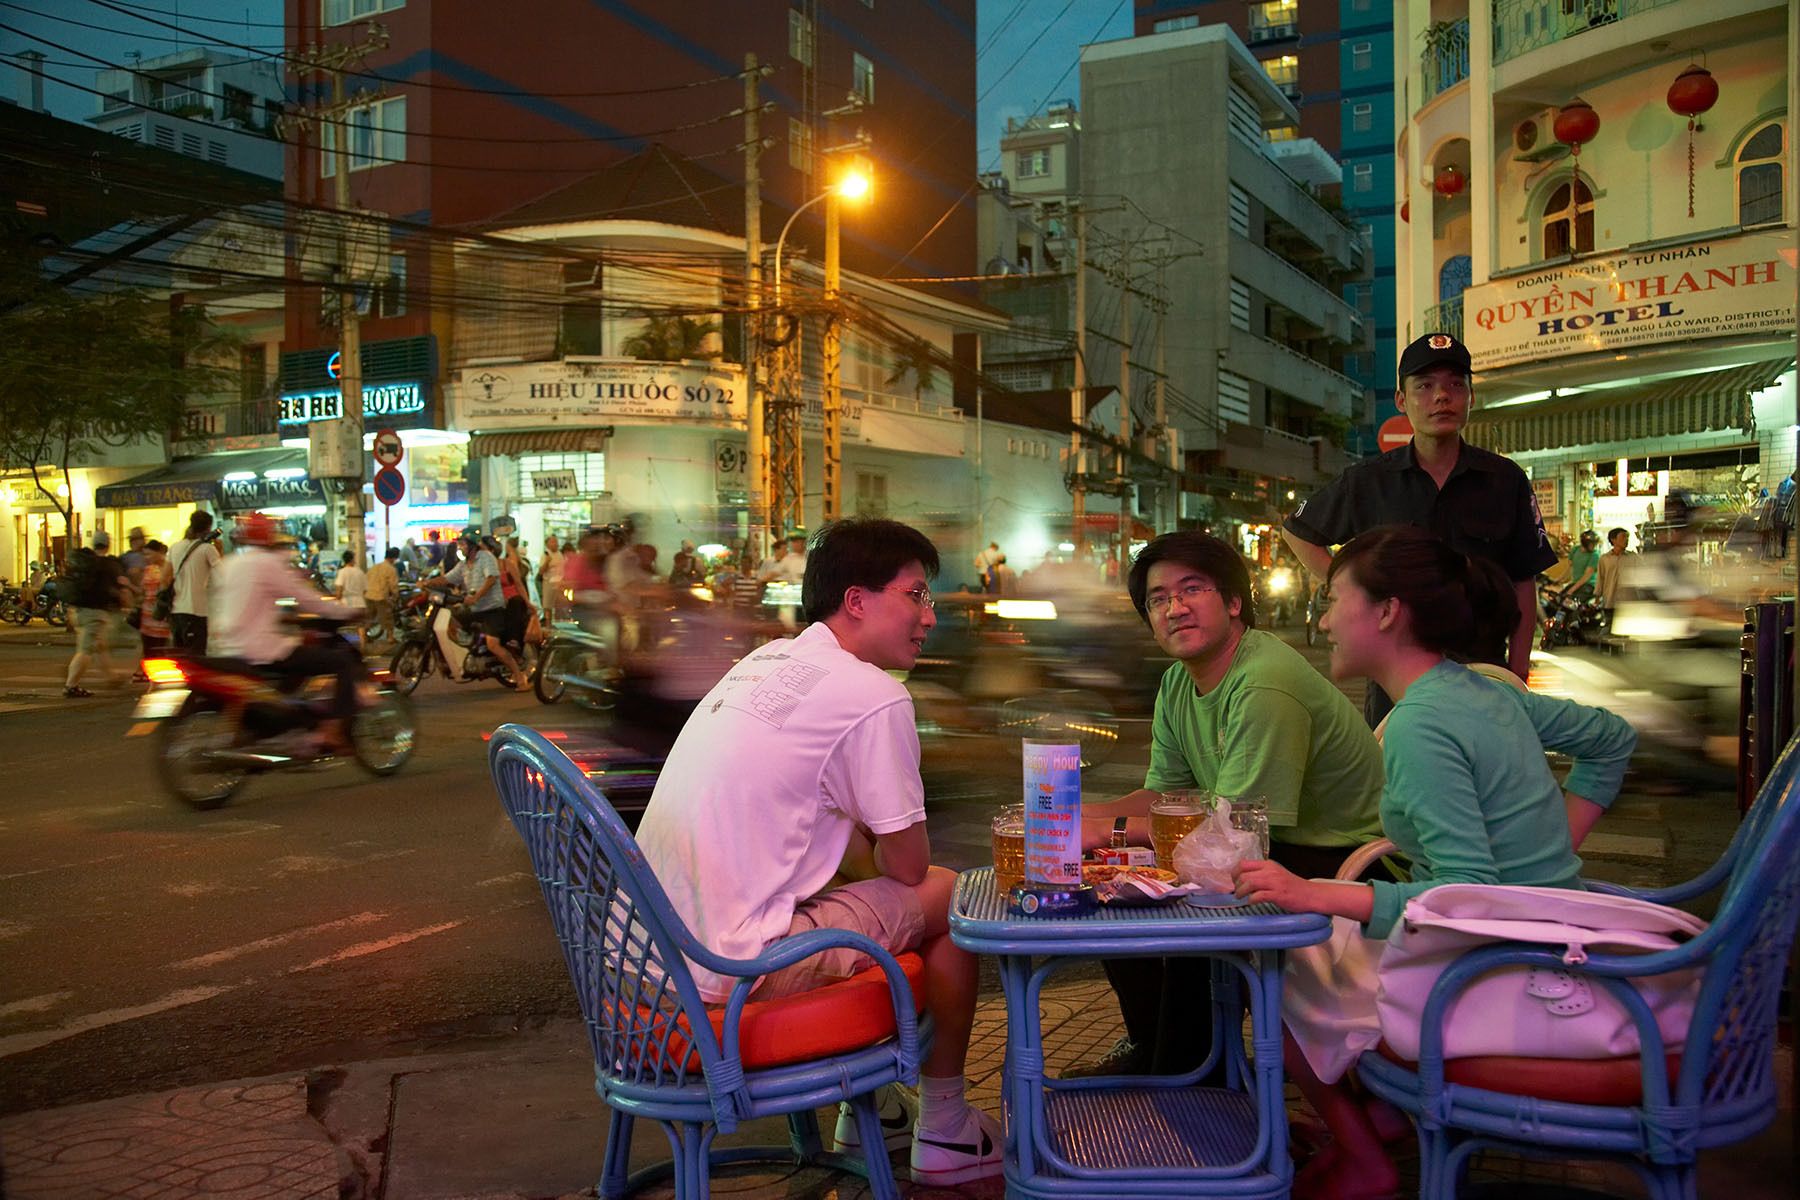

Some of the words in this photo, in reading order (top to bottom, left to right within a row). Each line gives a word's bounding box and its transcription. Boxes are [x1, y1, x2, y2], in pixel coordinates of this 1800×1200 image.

[1516, 272, 1563, 289] DOANH
[1660, 246, 1711, 261] NHÂN
[1608, 260, 1782, 303] THANH
[1538, 301, 1685, 336] HOTEL
[1684, 315, 1722, 327] WARD,
[530, 378, 585, 401] HIỆU
[590, 377, 679, 401] THUỐC
[684, 380, 711, 403] SỐ
[716, 388, 734, 404] 22
[852, 406, 861, 420] 22
[533, 476, 573, 489] PHARMACY
[1038, 795, 1052, 810] FREE
[1063, 863, 1079, 877] FREE
